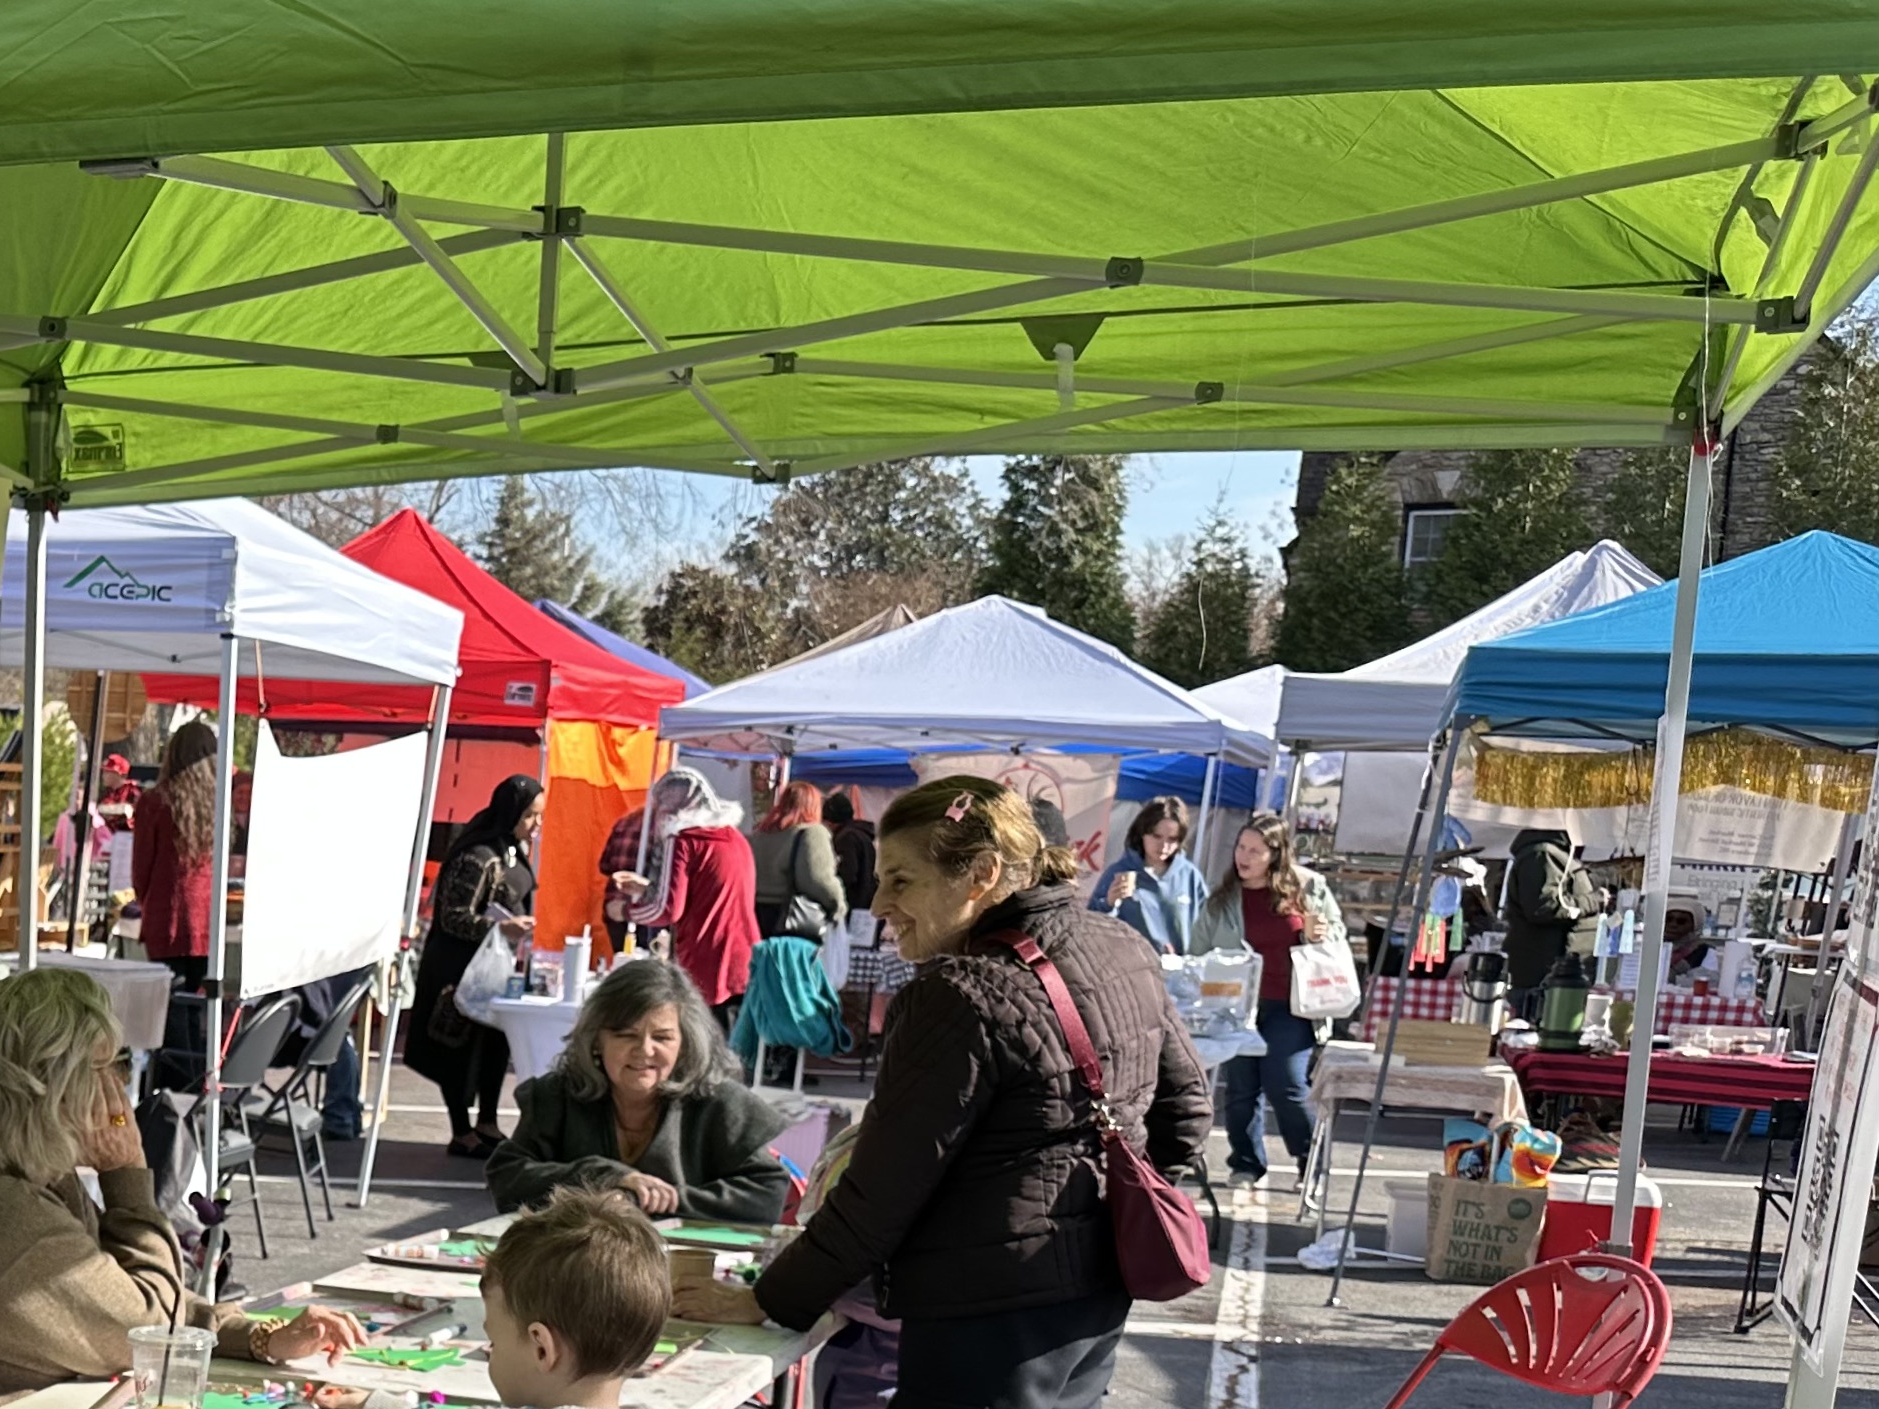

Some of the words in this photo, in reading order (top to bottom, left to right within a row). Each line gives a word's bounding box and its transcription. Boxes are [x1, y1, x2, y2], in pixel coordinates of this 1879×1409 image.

[1451, 1219, 1519, 1244] WHAT'S
[1447, 1240, 1481, 1258] NOT
[1484, 1244, 1503, 1261] IN
[1444, 1258, 1478, 1279] THE
